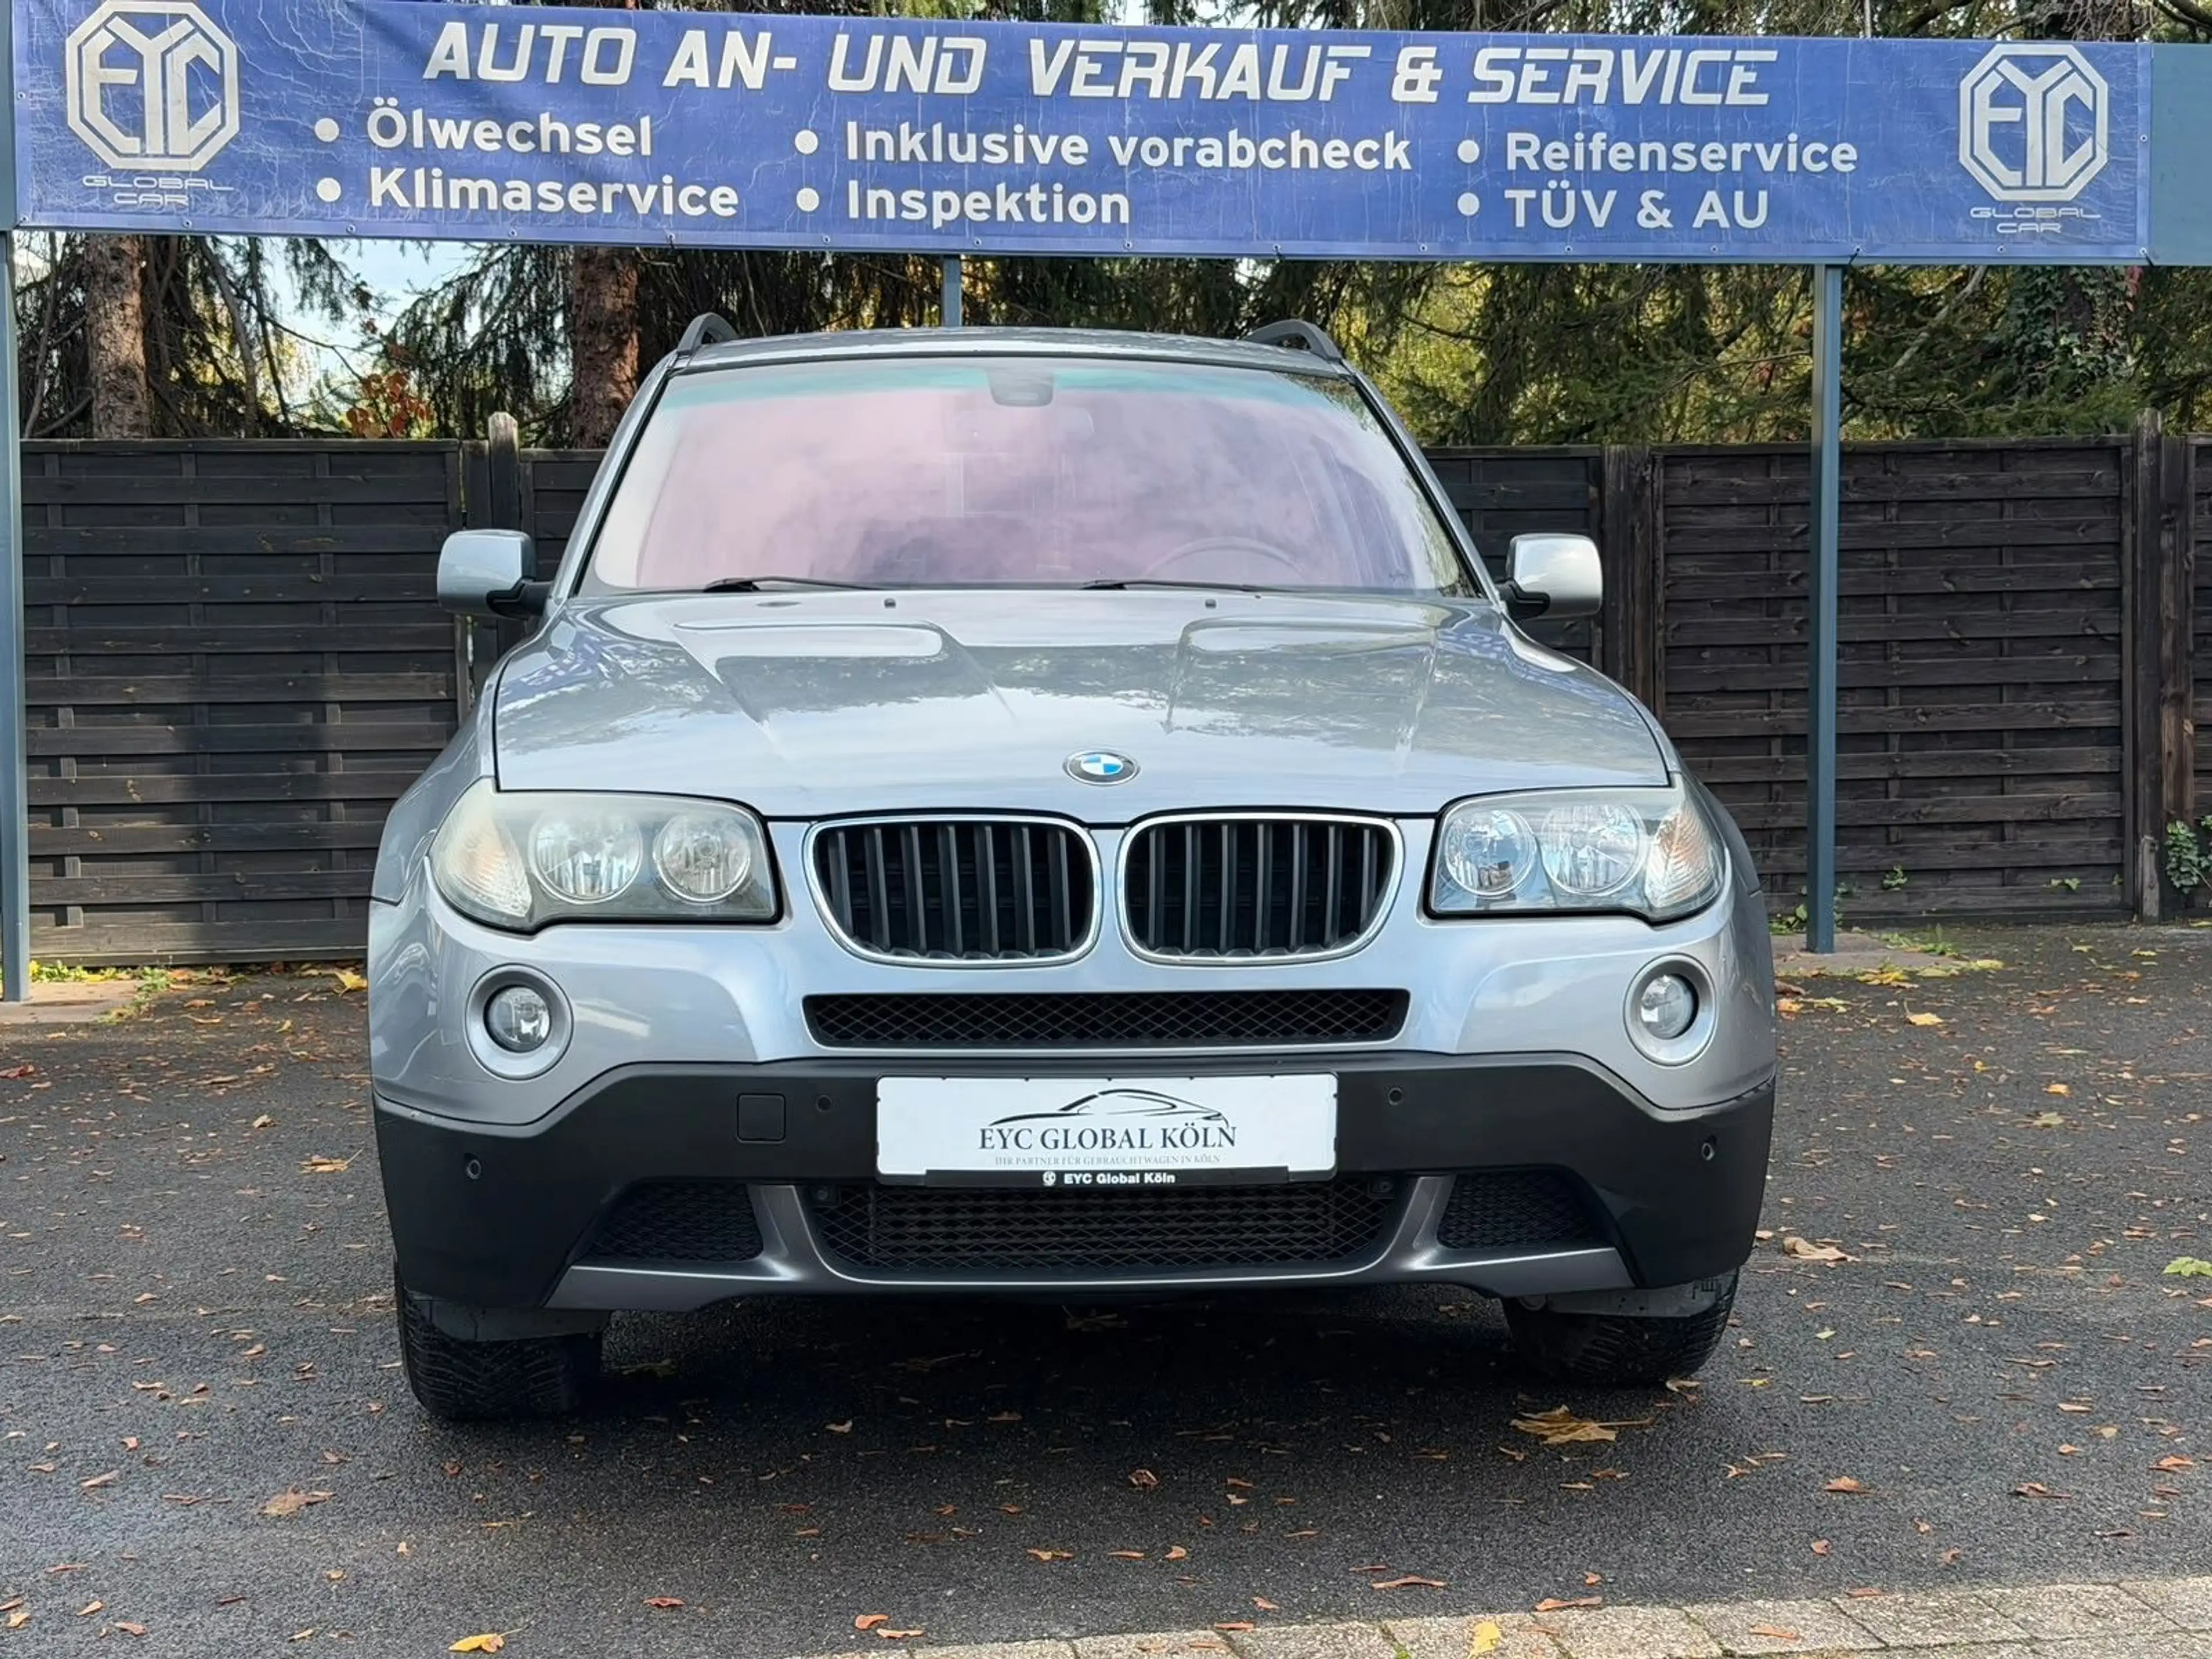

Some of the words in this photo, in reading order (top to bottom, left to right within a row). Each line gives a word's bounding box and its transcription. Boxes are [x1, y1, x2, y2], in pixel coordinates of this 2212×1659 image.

[423, 21, 637, 85] AUTO
[662, 30, 798, 89] AN-
[828, 33, 987, 94] UND
[1029, 38, 1372, 101] VERKAUF
[1391, 46, 1443, 103] &
[1467, 47, 1778, 105] SERVICE
[368, 97, 652, 156] Ölwechsel
[847, 121, 1089, 166] Inklusive
[1108, 129, 1412, 171] vorabcheck
[1508, 124, 1858, 172] Reifenservice
[83, 175, 234, 191] GLOBAL
[113, 193, 189, 206] CAR
[370, 166, 739, 217] Klimaservice
[849, 180, 1130, 230] Inspektion
[1505, 180, 1616, 228] TÜV
[1637, 190, 1673, 228] &
[1692, 190, 1768, 228] AU
[1970, 207, 2101, 218] GLOBAL
[1997, 222, 2062, 233] CAR
[979, 1128, 1033, 1150] EYC
[1040, 1127, 1153, 1150] GLOBAL
[1161, 1122, 1237, 1149] KÖLN
[1064, 1173, 1092, 1184] EYC
[1096, 1172, 1140, 1184] Global
[1144, 1172, 1176, 1184] Köln
